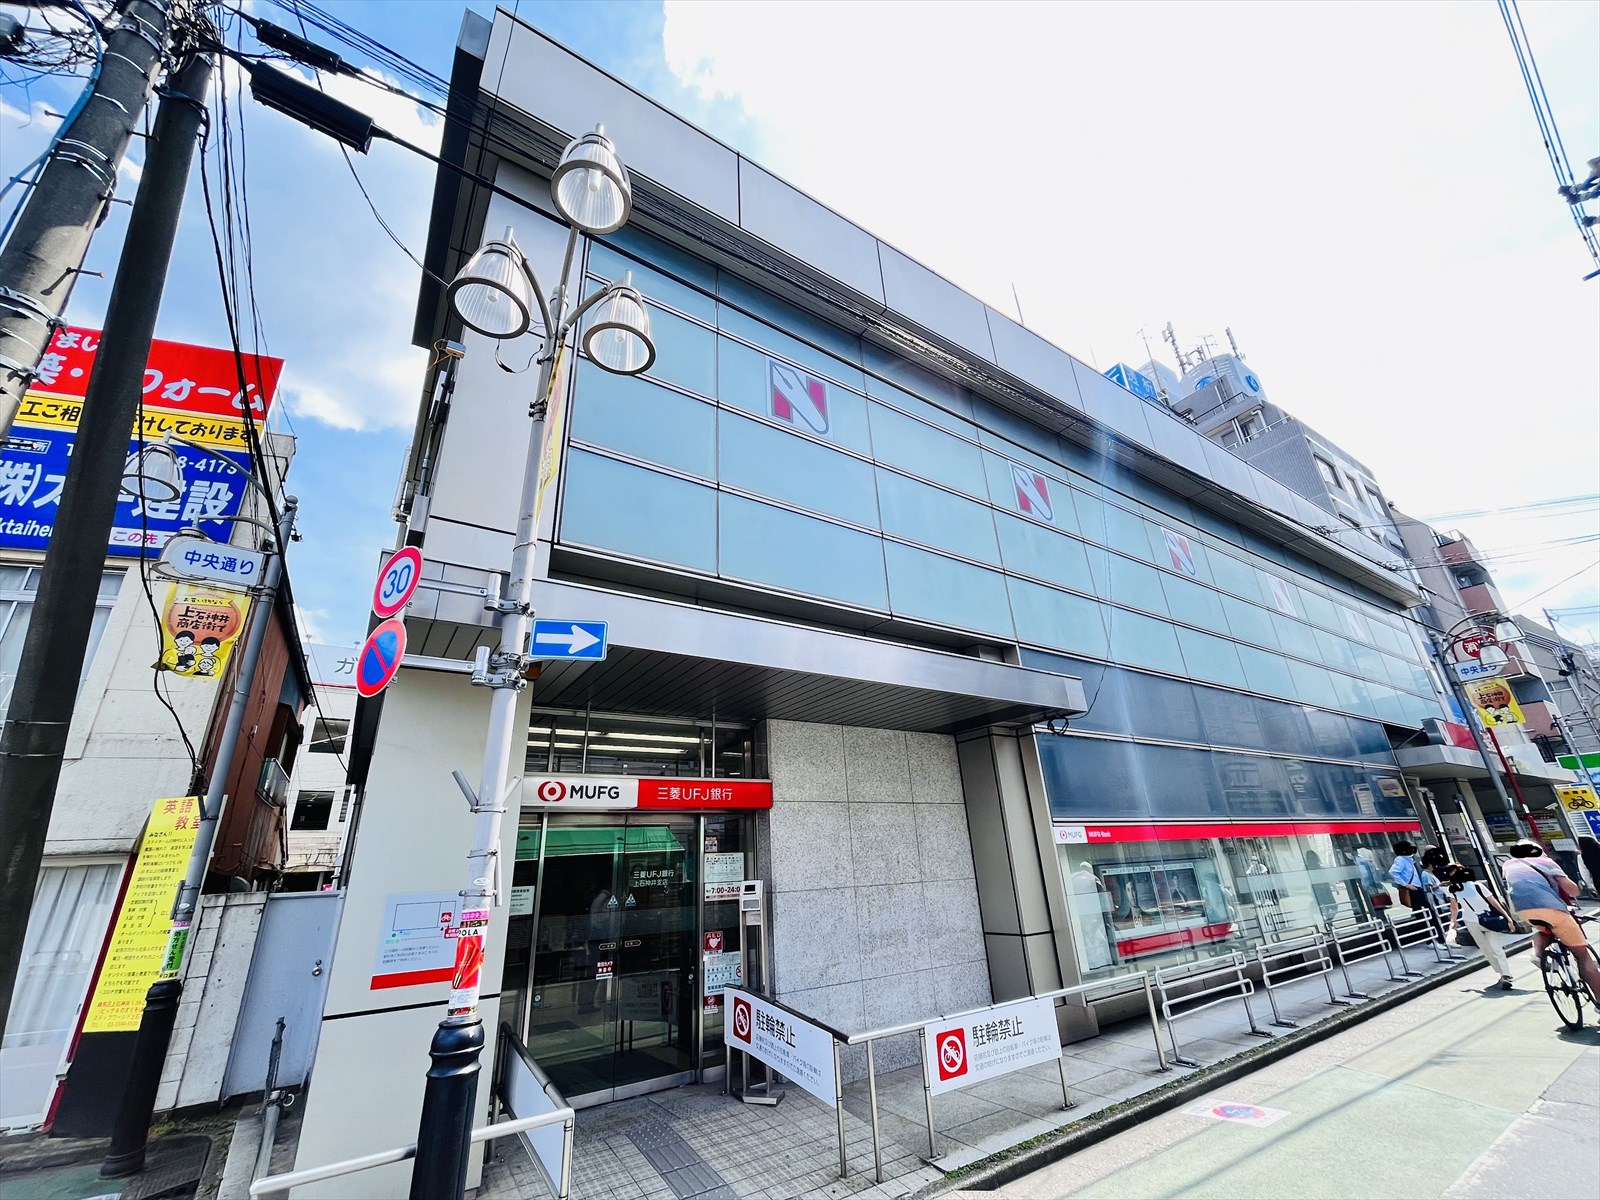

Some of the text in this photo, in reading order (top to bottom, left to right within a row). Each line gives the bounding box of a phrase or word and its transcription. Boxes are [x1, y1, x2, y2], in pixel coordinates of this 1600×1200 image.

[185, 550, 254, 575] 中央通り
[383, 564, 411, 599] 30
[178, 606, 230, 623] 上石神井
[177, 618, 227, 632] 商店街で
[570, 785, 620, 800] MUFG
[657, 787, 733, 801] 三菱UFJ銀行
[163, 799, 194, 814] 英語
[633, 869, 674, 879] 三菱UFJ銀行
[633, 879, 668, 888] 上石神井支店
[756, 1008, 796, 1048] 駐輪禁止
[972, 1016, 1024, 1047] 駐輪禁止
